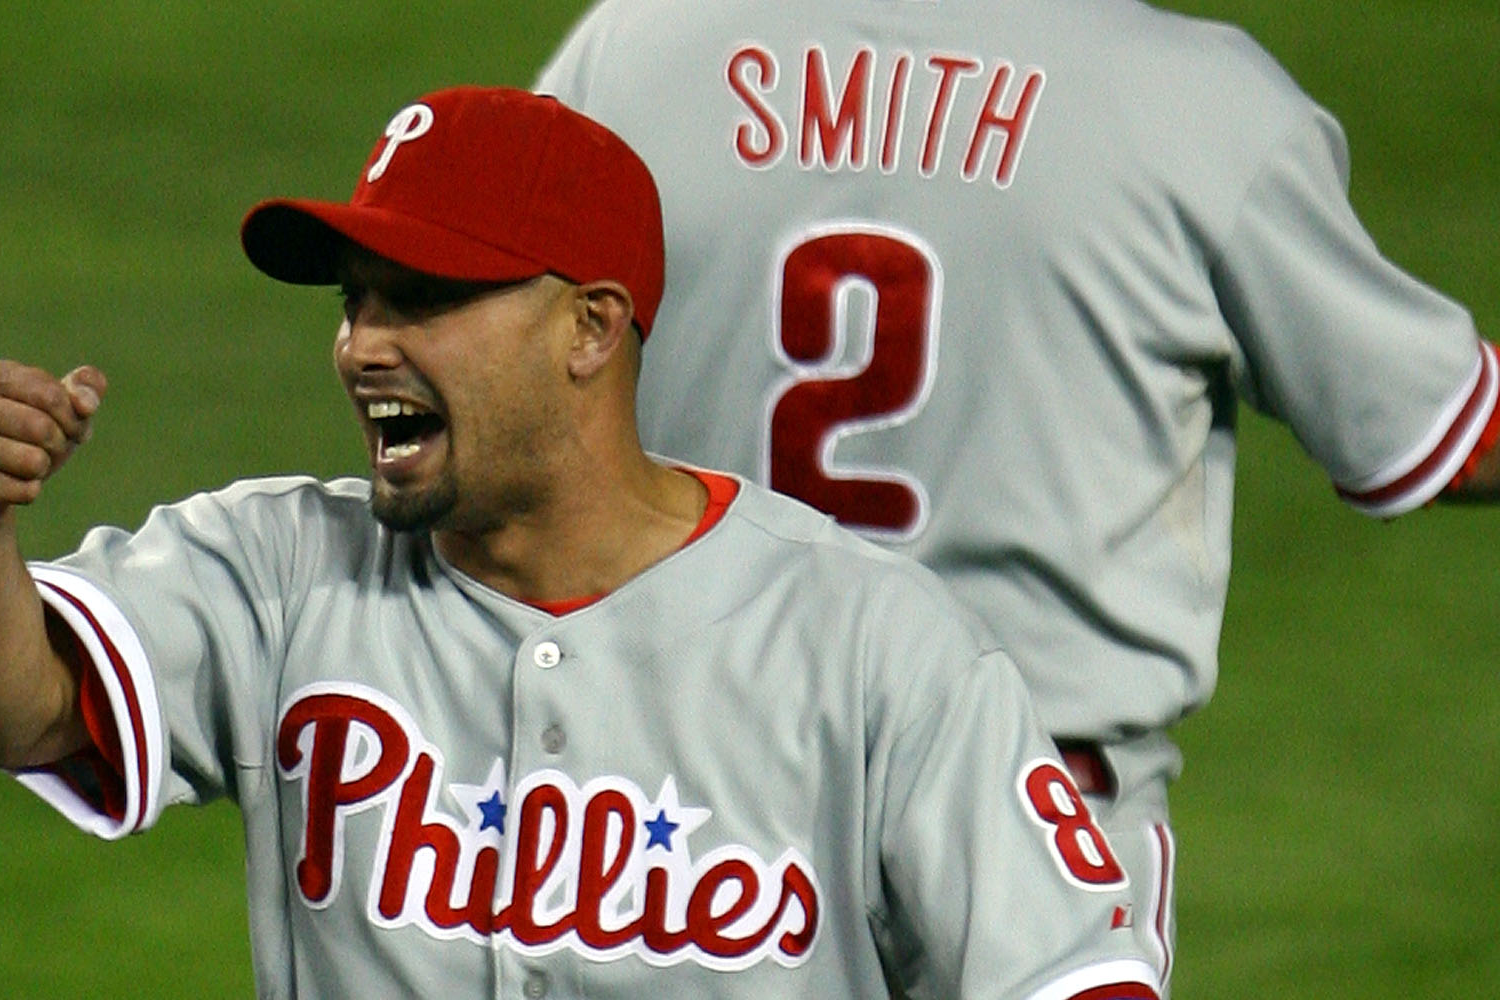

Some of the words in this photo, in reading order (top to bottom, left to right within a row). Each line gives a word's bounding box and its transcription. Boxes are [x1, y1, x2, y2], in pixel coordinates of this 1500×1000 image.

[368, 104, 434, 183] P
[725, 44, 1046, 188] SMITH
[761, 219, 944, 545] 2
[277, 681, 820, 971] Phillies
[1017, 757, 1130, 892] 8
